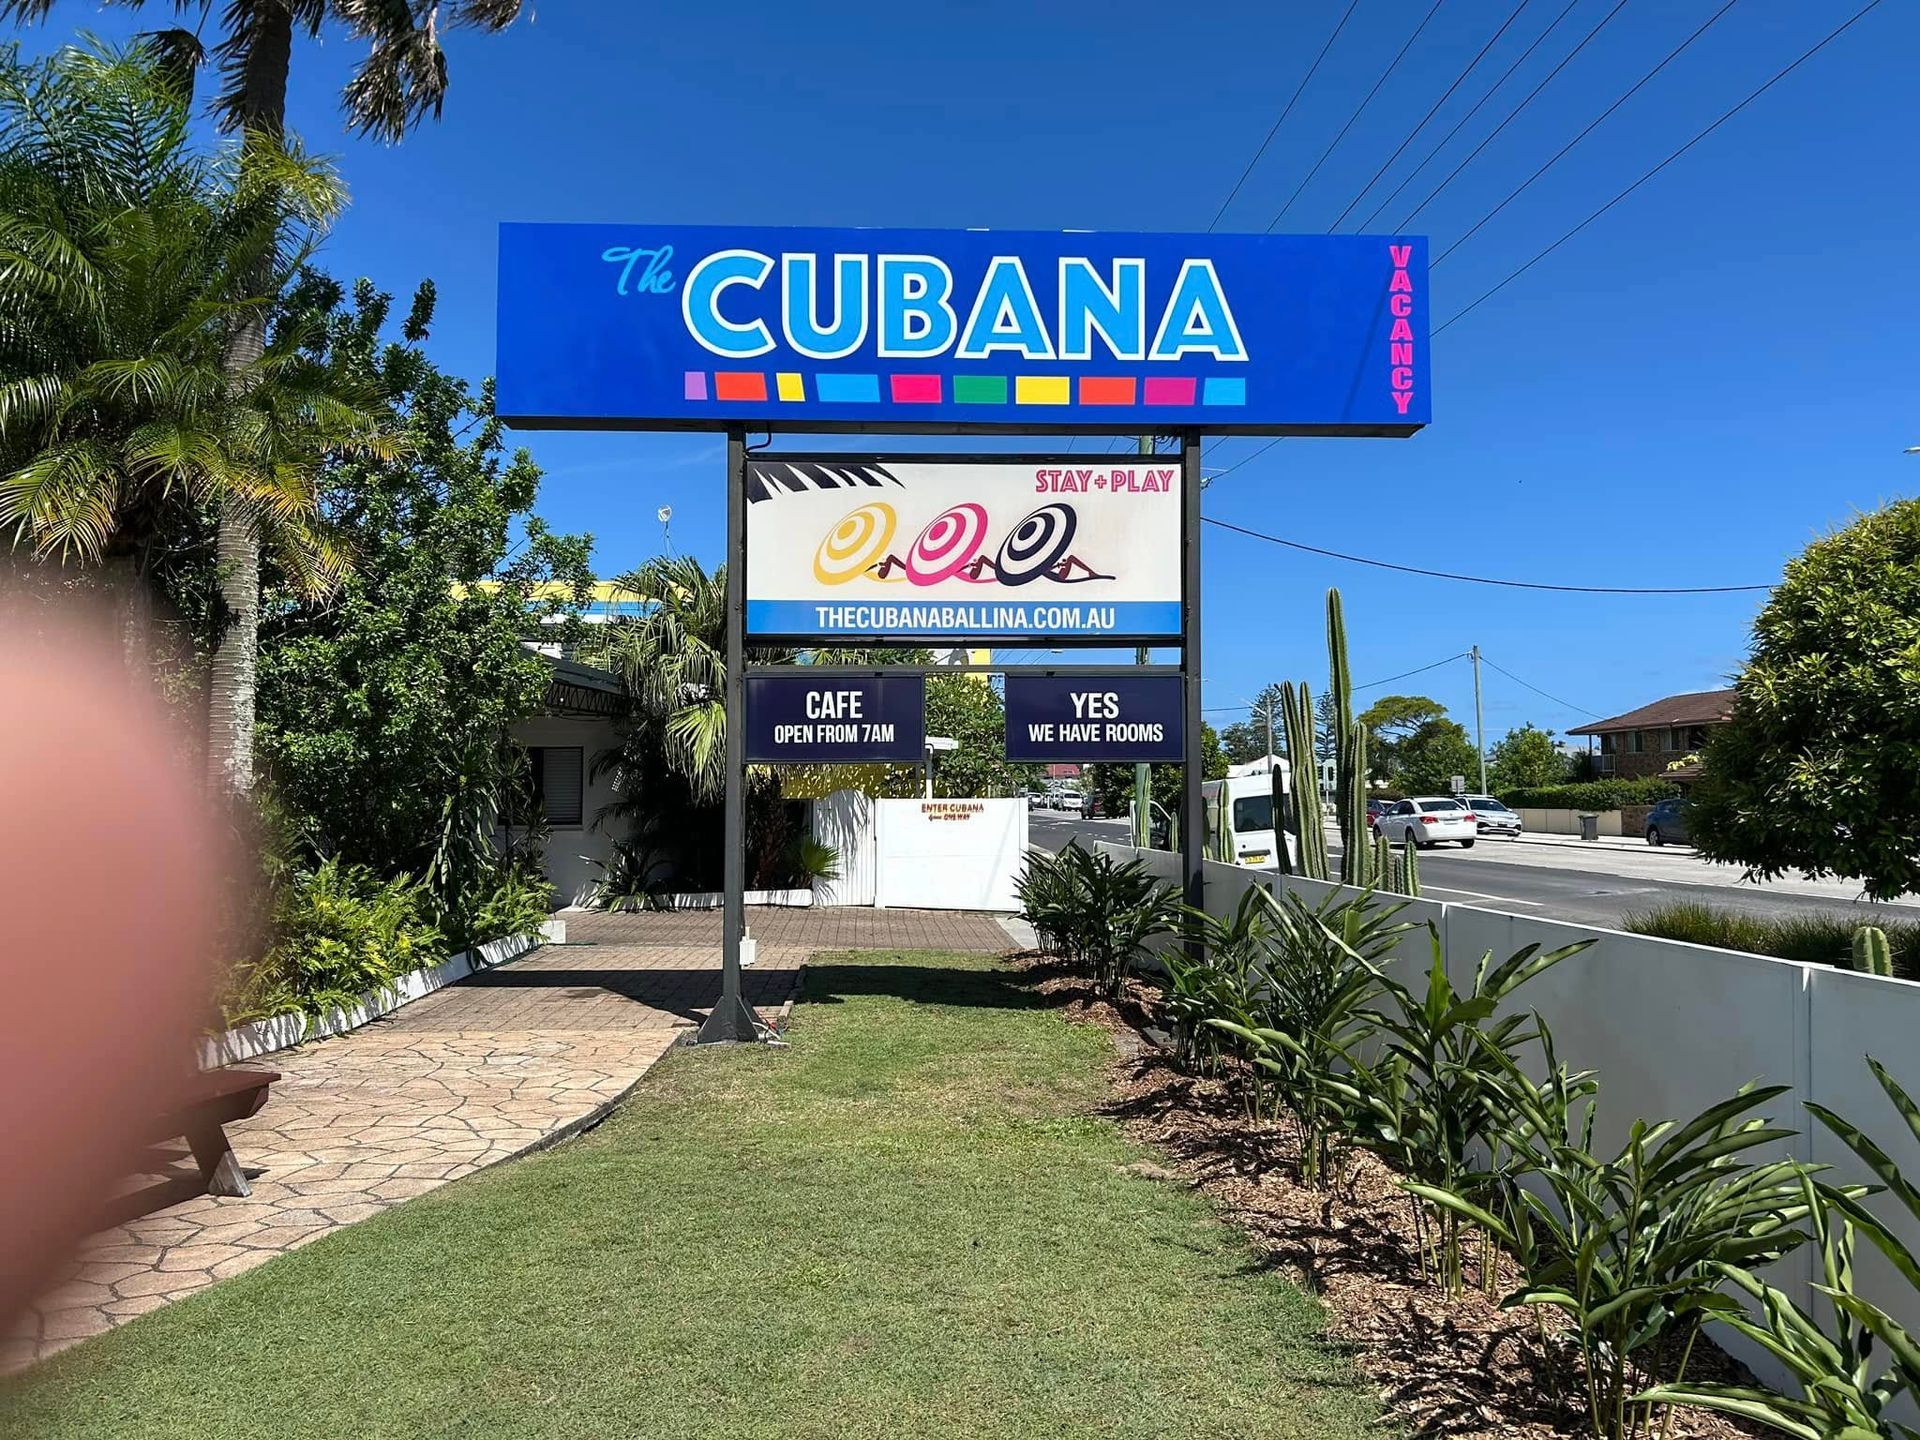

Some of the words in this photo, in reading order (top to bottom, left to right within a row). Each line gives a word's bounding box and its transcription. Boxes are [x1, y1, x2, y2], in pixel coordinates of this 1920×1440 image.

[601, 245, 677, 296] The
[681, 249, 1250, 361] CUBANA
[1389, 245, 1414, 414] VACANCY
[815, 606, 1116, 629] THECUBANABALLINA.COM.AU
[806, 691, 863, 719] CAFE
[1070, 692, 1119, 719] YES
[774, 724, 813, 743] OPEN
[817, 724, 858, 743] FROM
[861, 724, 895, 742] 7AM
[1028, 724, 1054, 742] WE
[1059, 723, 1101, 742] HAVE
[1105, 723, 1164, 742] ROOMS
[921, 803, 948, 813] ENTER
[949, 803, 985, 813] CUBANA
